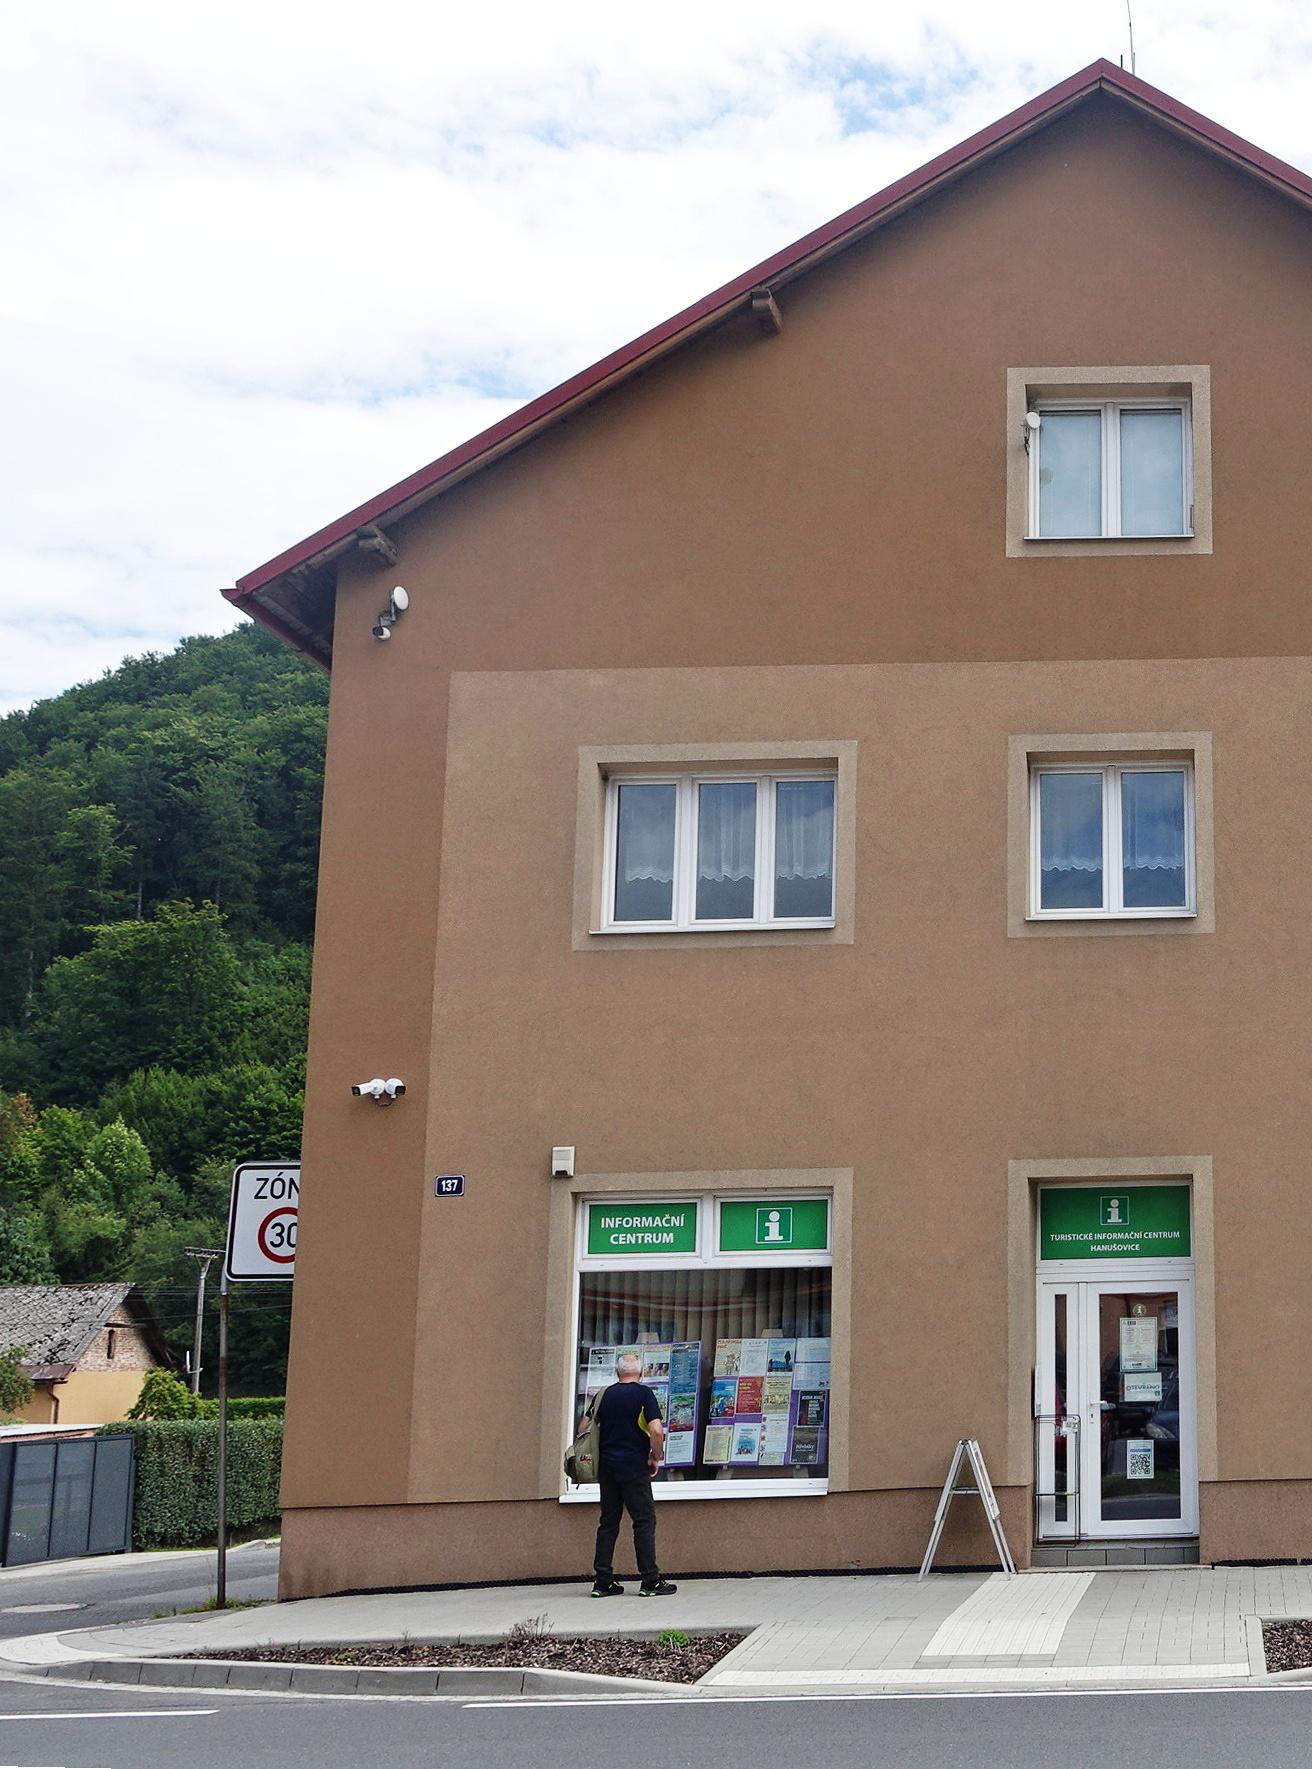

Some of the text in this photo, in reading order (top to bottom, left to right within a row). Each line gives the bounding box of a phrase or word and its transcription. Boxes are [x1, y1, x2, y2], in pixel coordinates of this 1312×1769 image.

[253, 1172, 300, 1200] ZÓN
[441, 1179, 458, 1192] 137
[601, 1213, 685, 1229] INFORMAČNÍ
[269, 1222, 297, 1248] 30
[610, 1232, 674, 1245] CENTRUM
[1050, 1230, 1180, 1241] TURISTICKÉ INFORMAČNÍ CENTRUM
[1090, 1243, 1140, 1252] HANUŠOVICE
